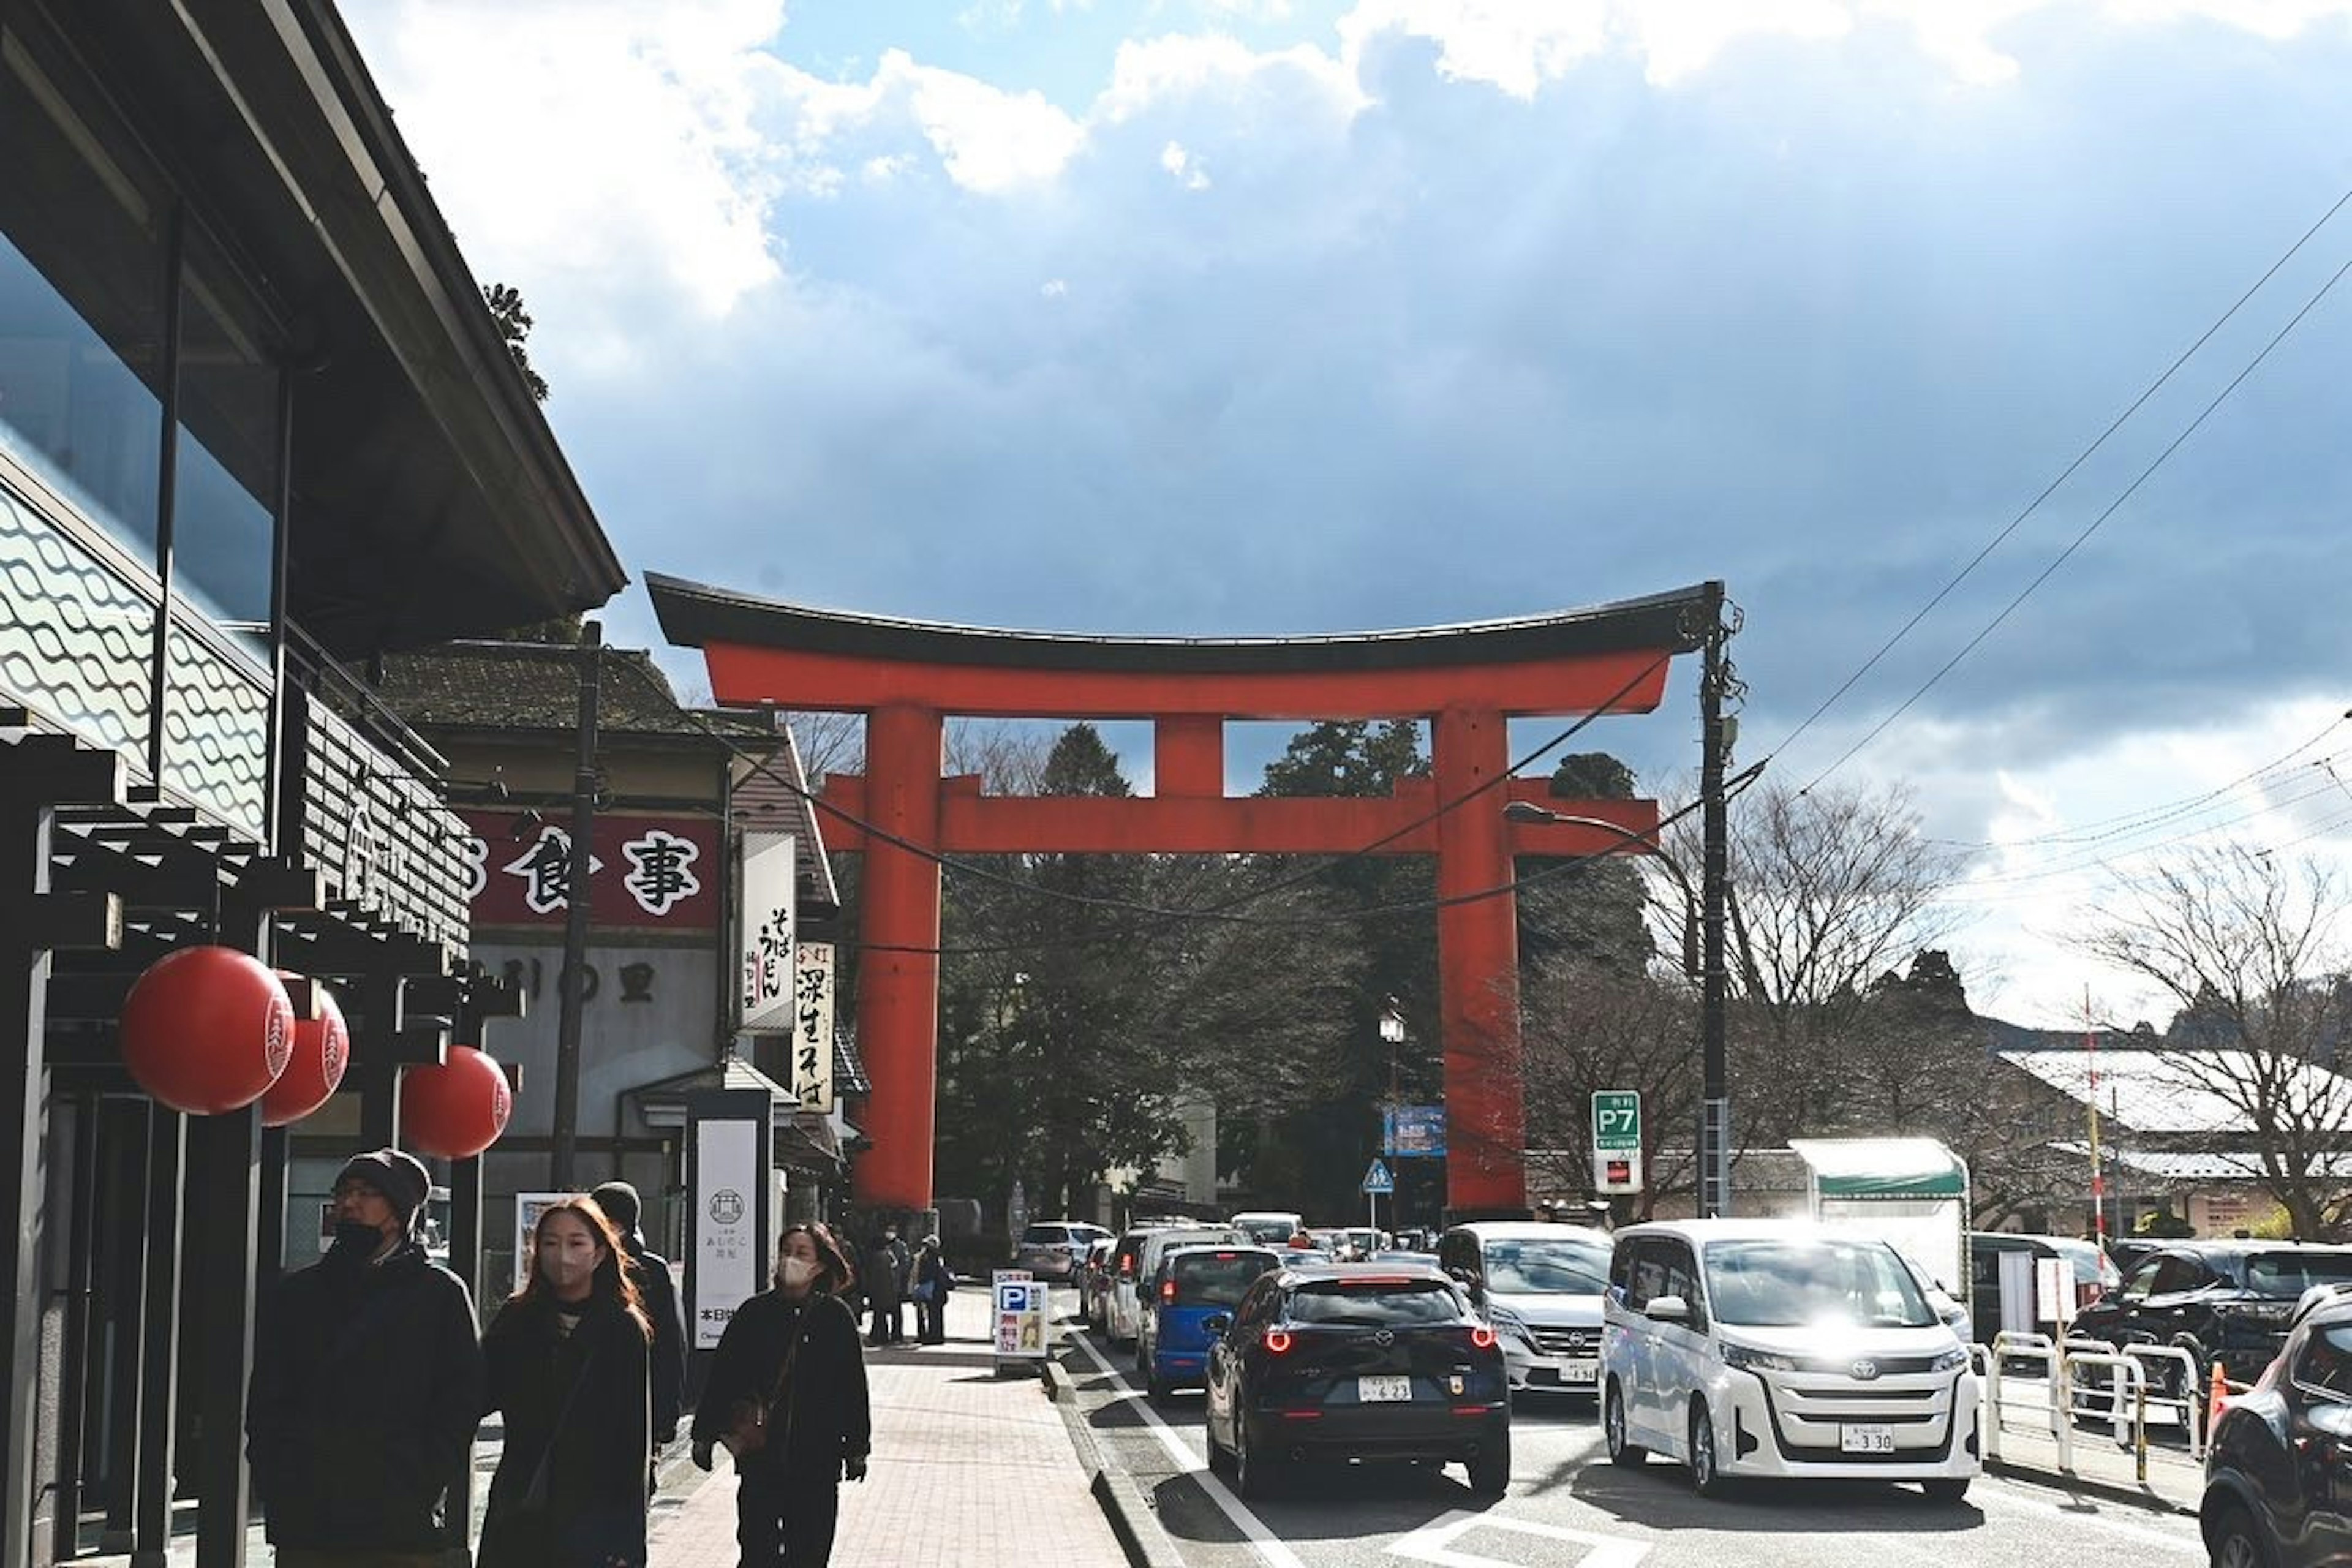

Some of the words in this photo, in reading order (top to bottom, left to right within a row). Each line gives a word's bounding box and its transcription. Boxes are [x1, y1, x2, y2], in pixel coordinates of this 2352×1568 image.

[772, 908, 790, 958] そば
[759, 925, 780, 1000] うどん
[1599, 1109, 1635, 1132] P7
[1003, 1288, 1025, 1309] P
